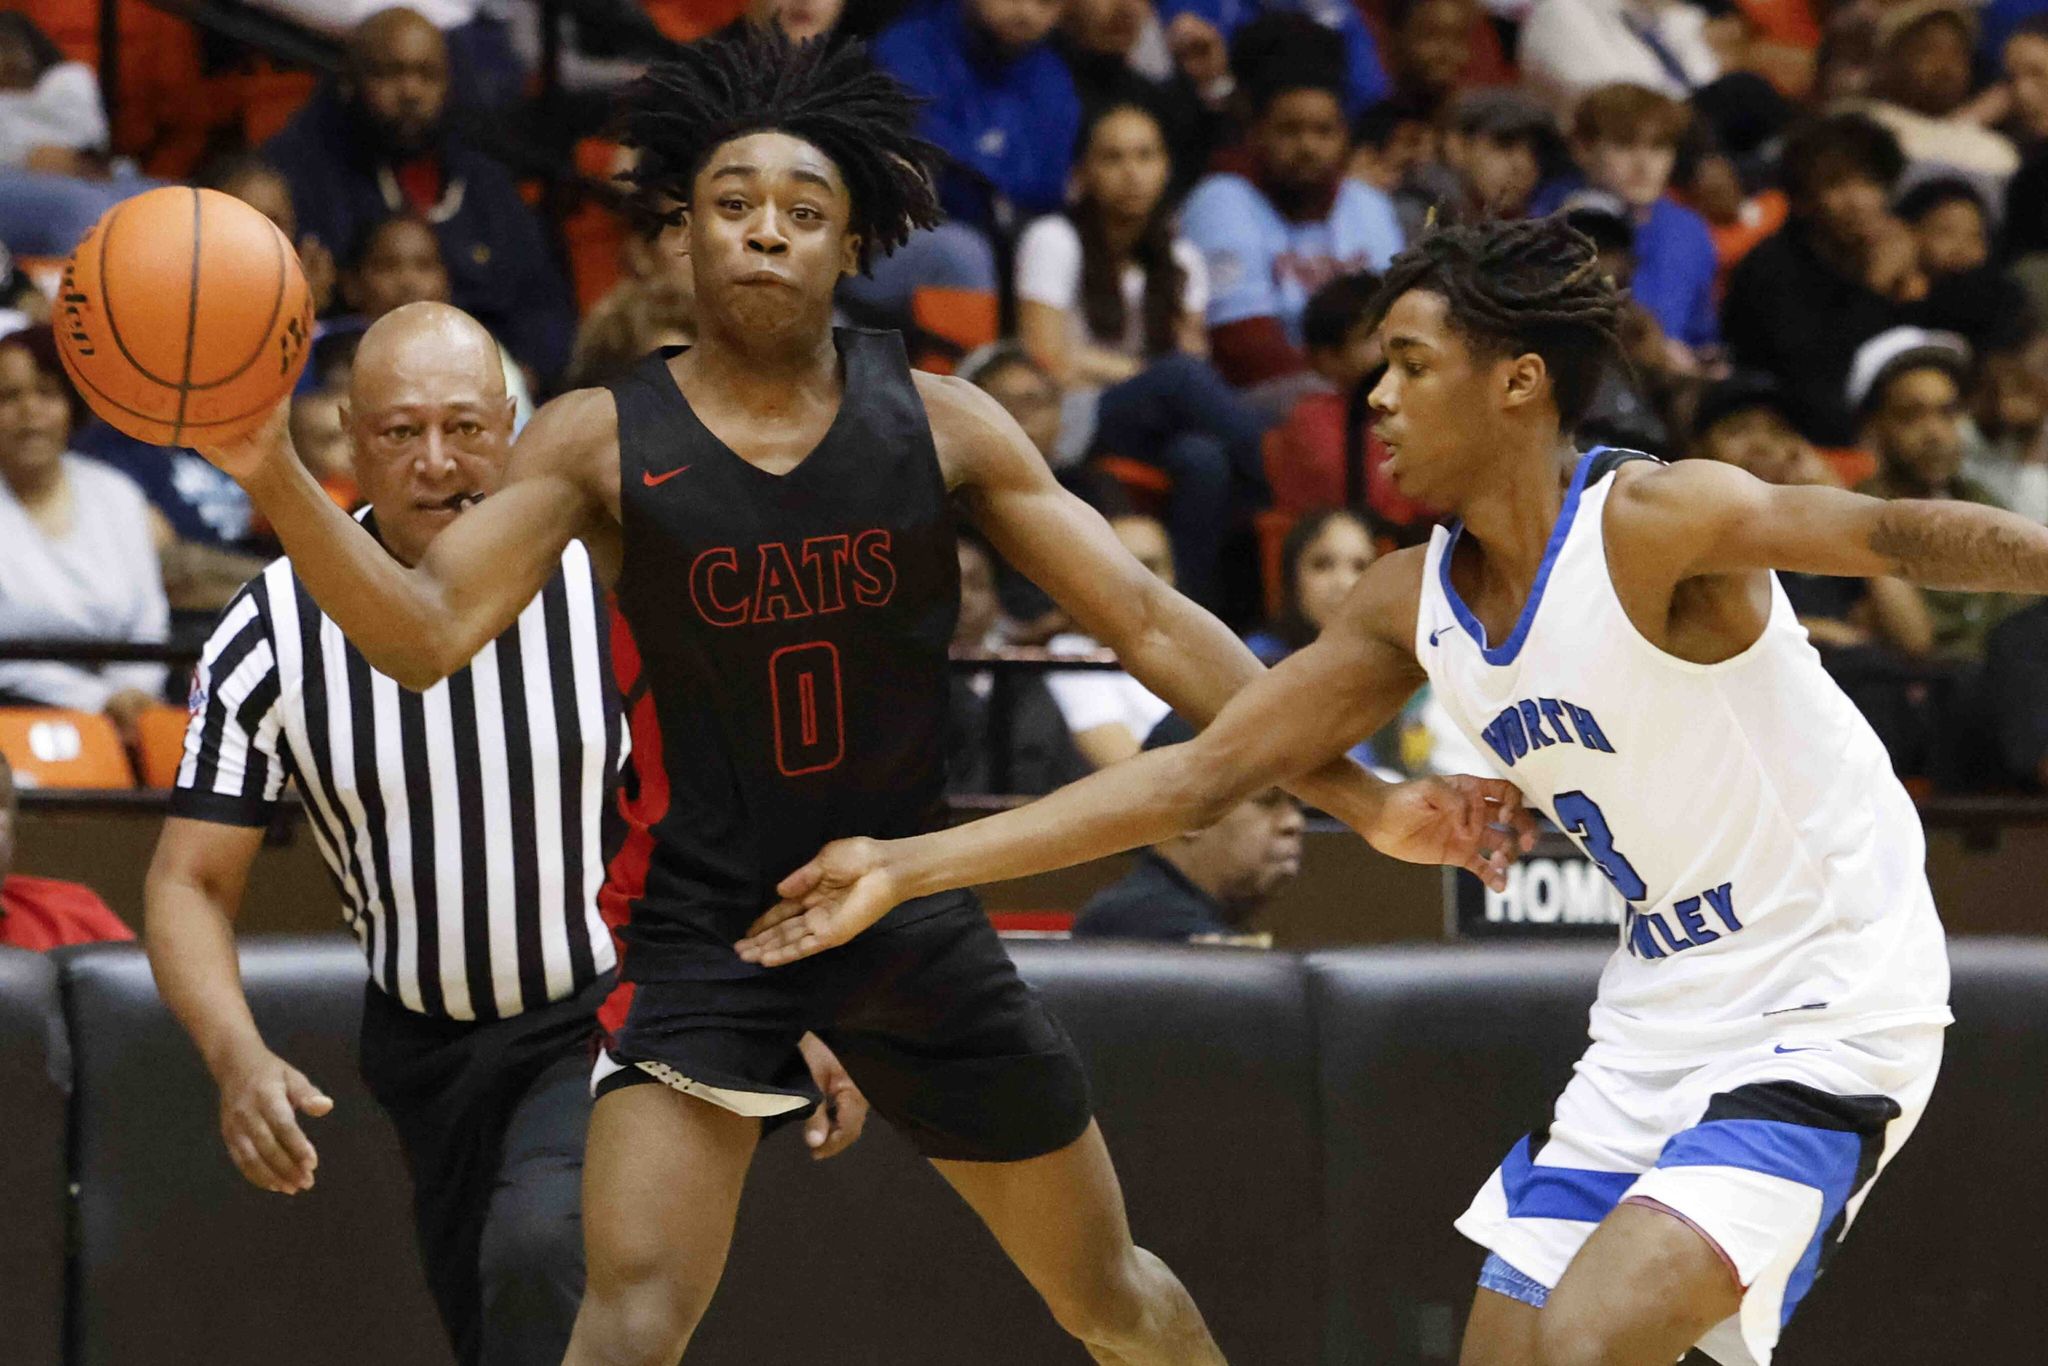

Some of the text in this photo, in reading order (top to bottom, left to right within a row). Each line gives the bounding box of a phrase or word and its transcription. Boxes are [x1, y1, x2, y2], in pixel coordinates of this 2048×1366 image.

[689, 529, 897, 627] CATS
[769, 640, 846, 777] 0
[1486, 857, 1621, 924] HOM
[1553, 790, 1647, 901] 3
